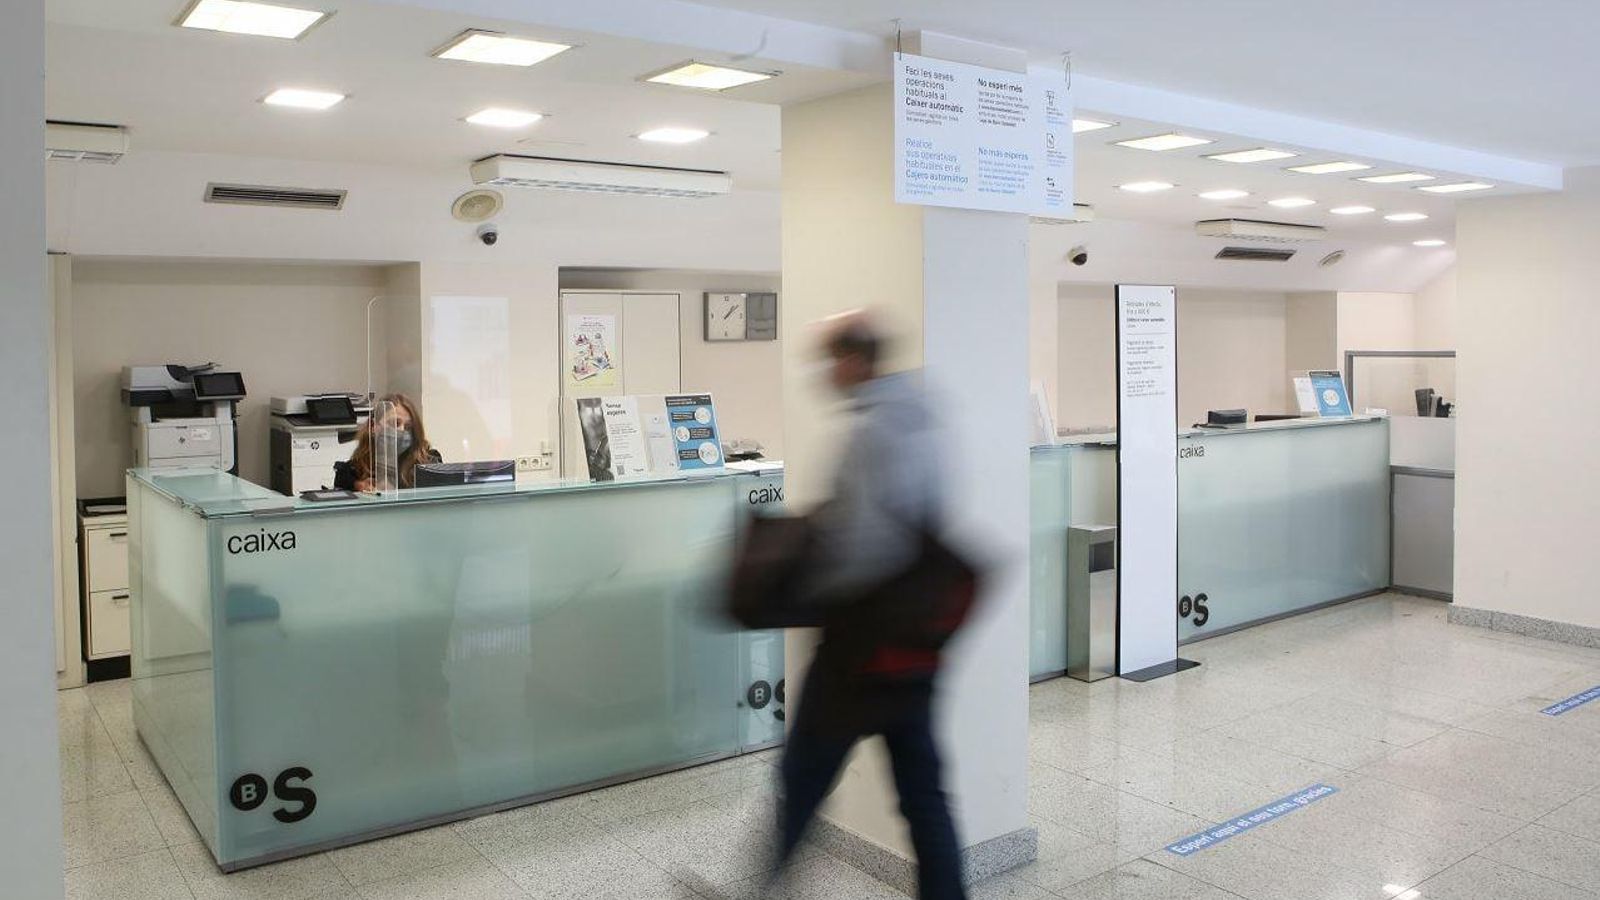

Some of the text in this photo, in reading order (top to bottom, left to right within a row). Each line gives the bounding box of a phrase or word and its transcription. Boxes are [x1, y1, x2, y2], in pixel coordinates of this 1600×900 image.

[905, 78, 945, 90] operacions
[978, 78, 987, 87] No
[905, 87, 939, 100] habituals
[905, 97, 928, 108] Caixer
[978, 147, 987, 156] No
[905, 160, 943, 171] habituales
[905, 169, 929, 181] Cajero
[1180, 443, 1205, 459] caixa
[749, 483, 785, 505] caix
[227, 527, 297, 555] caixa
